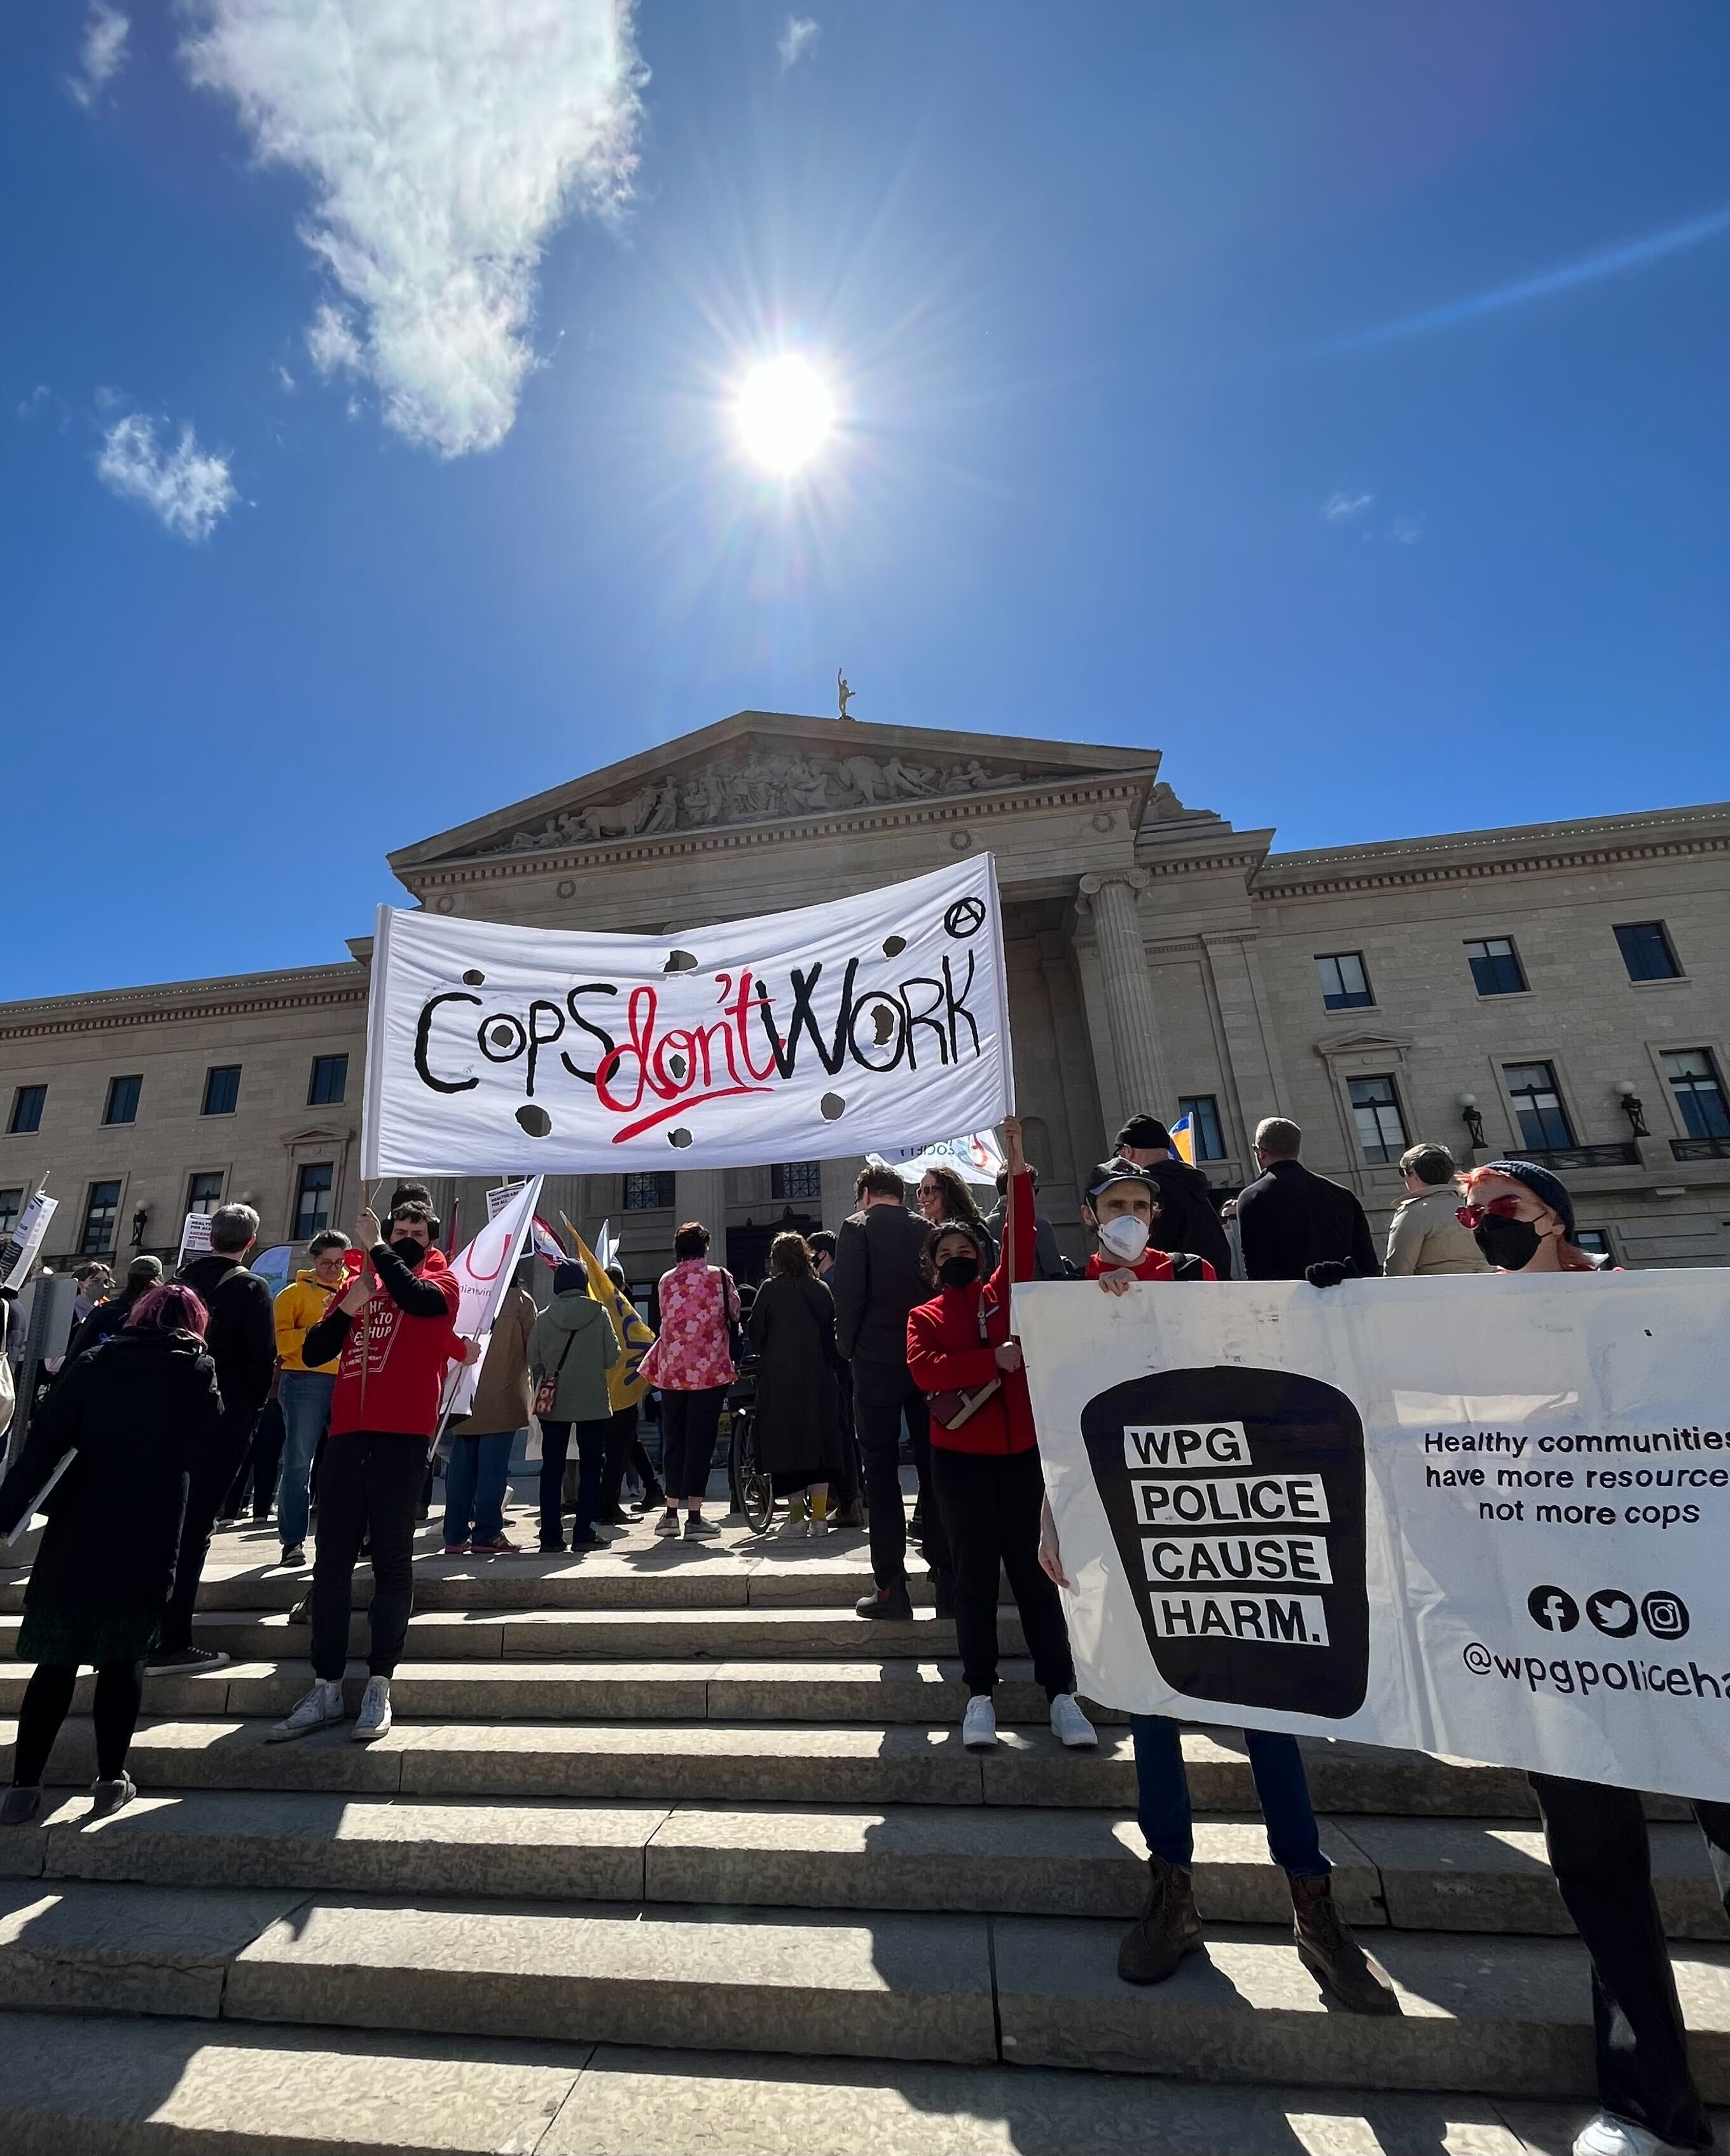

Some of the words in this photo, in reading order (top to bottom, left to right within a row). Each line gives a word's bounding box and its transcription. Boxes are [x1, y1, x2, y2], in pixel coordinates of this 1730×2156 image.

[1130, 1428, 1242, 1464] WPG
[1425, 1432, 1528, 1458] Healthy
[1426, 1466, 1485, 1487] have
[1497, 1470, 1574, 1488] more
[1141, 1480, 1320, 1522] POLICE
[1479, 1500, 1525, 1521] not
[1536, 1504, 1616, 1525] more
[1624, 1503, 1701, 1529] cops
[1152, 1540, 1321, 1581] CAUSE
[1161, 1599, 1321, 1643] HARM.
